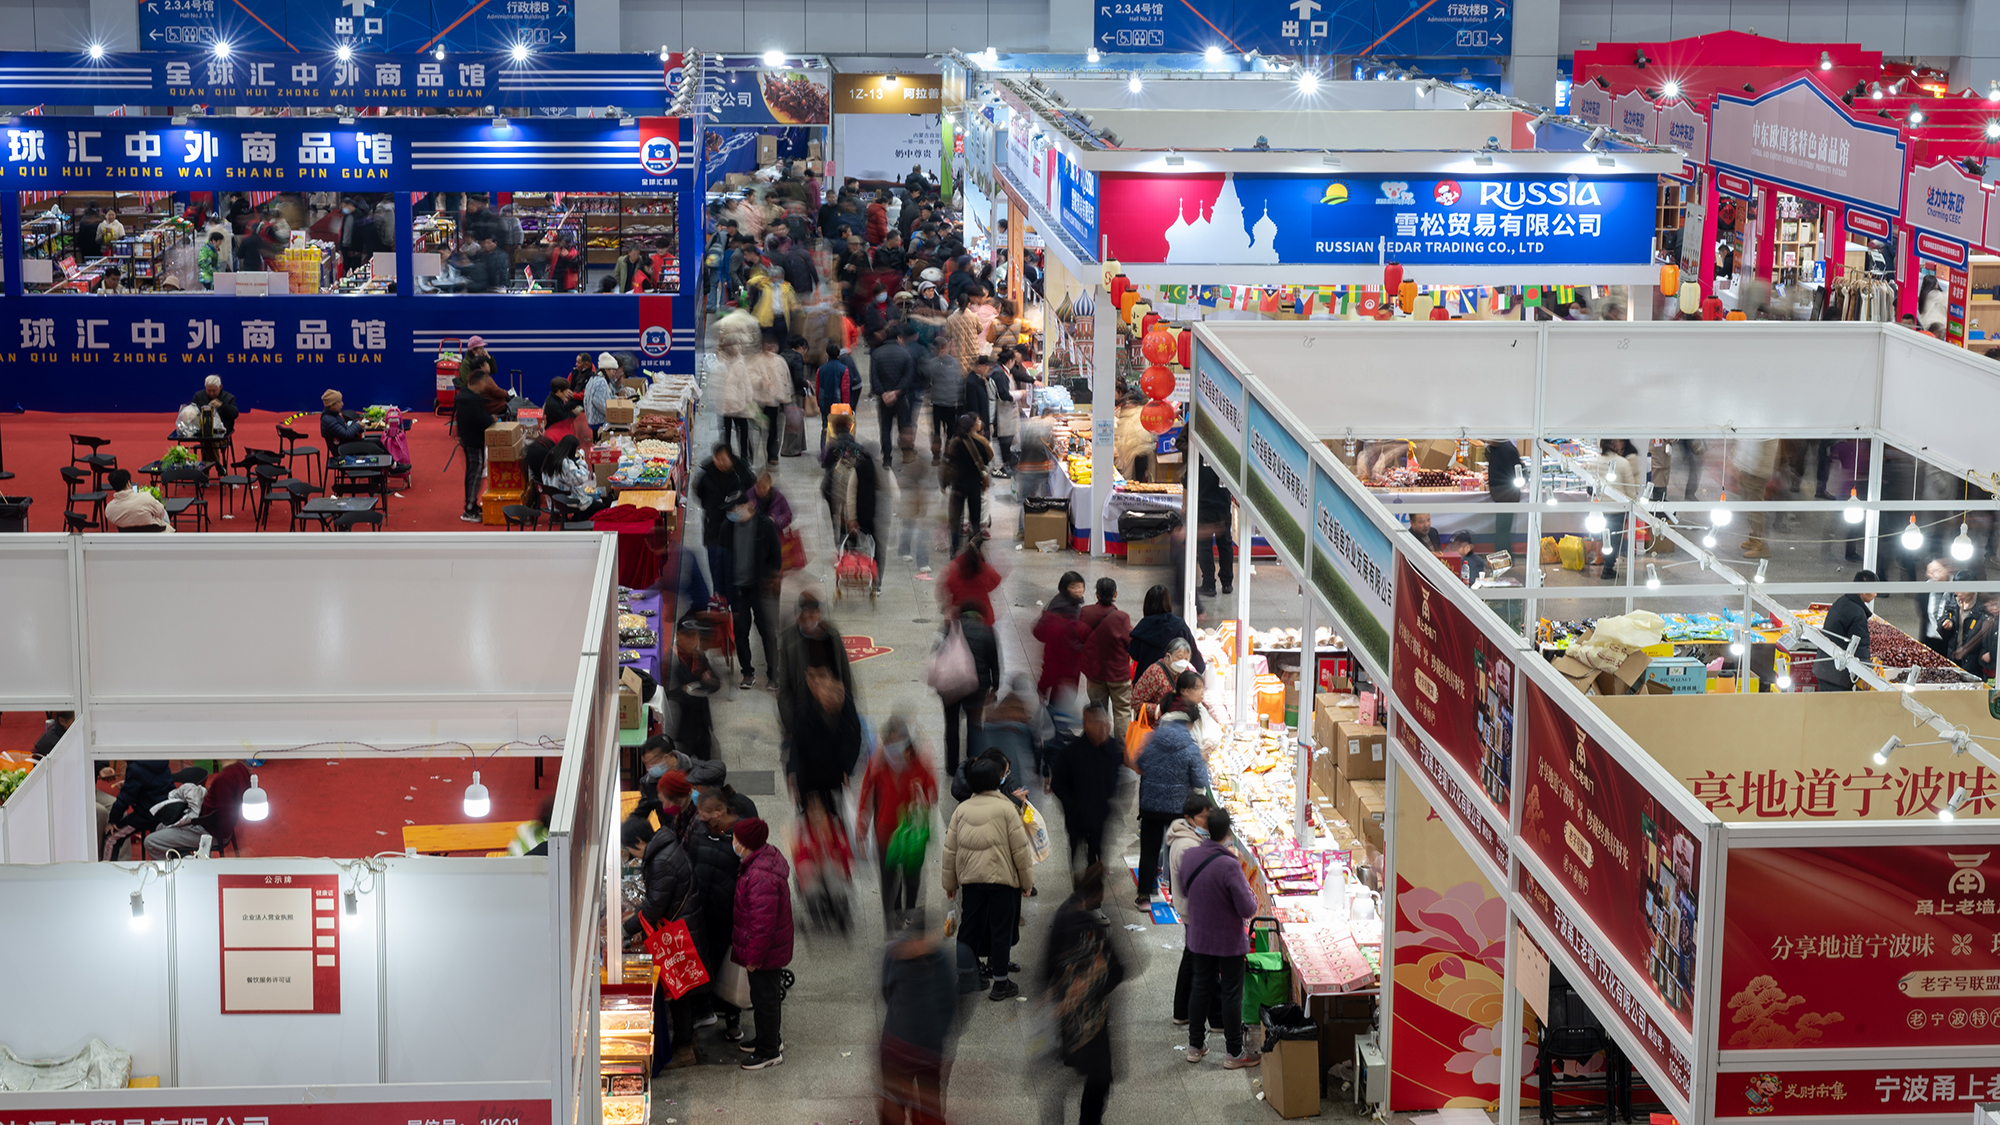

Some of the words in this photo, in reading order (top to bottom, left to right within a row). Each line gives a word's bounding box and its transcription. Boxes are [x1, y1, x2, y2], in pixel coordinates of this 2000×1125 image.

[164, 0, 215, 12] 2.3.4号馆
[507, 1, 550, 13] 行政楼B
[1115, 3, 1163, 16] 2.3.4号馆
[1447, 4, 1489, 16] 行政楼B
[523, 13, 545, 21] Building
[1463, 16, 1483, 24] Building
[335, 17, 383, 35] 出口
[1282, 20, 1328, 38] 出口
[344, 36, 373, 44] EXIT
[165, 62, 486, 87] 全球汇中外商品馆
[170, 88, 205, 97] QUAN
[215, 88, 236, 97] QIU
[246, 88, 267, 97] HUI
[277, 88, 319, 97] ZHONG
[330, 89, 355, 97] WAI
[364, 89, 407, 97] SHANG
[849, 88, 884, 100] 1Z-13
[903, 87, 942, 100] 阿拉善
[7, 129, 393, 164] 球汇中外商品馆
[1752, 119, 1850, 167] 中东欧国家特色商品馆
[19, 166, 47, 177] QIU
[62, 166, 91, 177] HUI
[106, 166, 163, 177] ZHONG
[178, 167, 211, 177] WAI
[226, 167, 284, 178] SHANG
[299, 168, 327, 178] PIN
[342, 168, 389, 178] GUAN
[1480, 181, 1602, 211] RUSSIA
[1926, 185, 1965, 214] 魅力中东欧
[1927, 207, 1949, 222] Charming
[1948, 213, 1961, 225] CEEC
[1395, 212, 1602, 238] 雪松贸易有限公司
[1315, 241, 1374, 253] RUSSIAN
[1425, 241, 1484, 253] TRADING
[1488, 241, 1515, 255] CO.,
[1519, 242, 1544, 253] LTD
[20, 318, 386, 350] 球汇中外商品馆
[1616, 338, 1630, 350] 28
[30, 353, 57, 363] QIU
[72, 353, 99, 363] HUI
[113, 353, 167, 363] ZHONG
[182, 353, 214, 363] WAI
[227, 353, 283, 363] SHANG
[297, 354, 324, 363] PIN
[338, 354, 382, 363] GUAN
[1569, 758, 1594, 796] 甬上老墙门
[1686, 765, 1998, 818] 享地道宁波味
[1538, 755, 1575, 812] 分享地道宁波味
[1586, 807, 1629, 871] 珍藏经典好时光
[264, 875, 292, 884] 公示牌
[315, 889, 334, 897] 健康证
[1914, 899, 2000, 916] 甬上老墙
[1771, 933, 1935, 960] 分享地道宁波味
[1553, 905, 1646, 1036] 宁波甬上老墙门文化有限公司
[246, 976, 292, 984] 餐饮服务许可证
[1920, 975, 2000, 992] 老字号联盟
